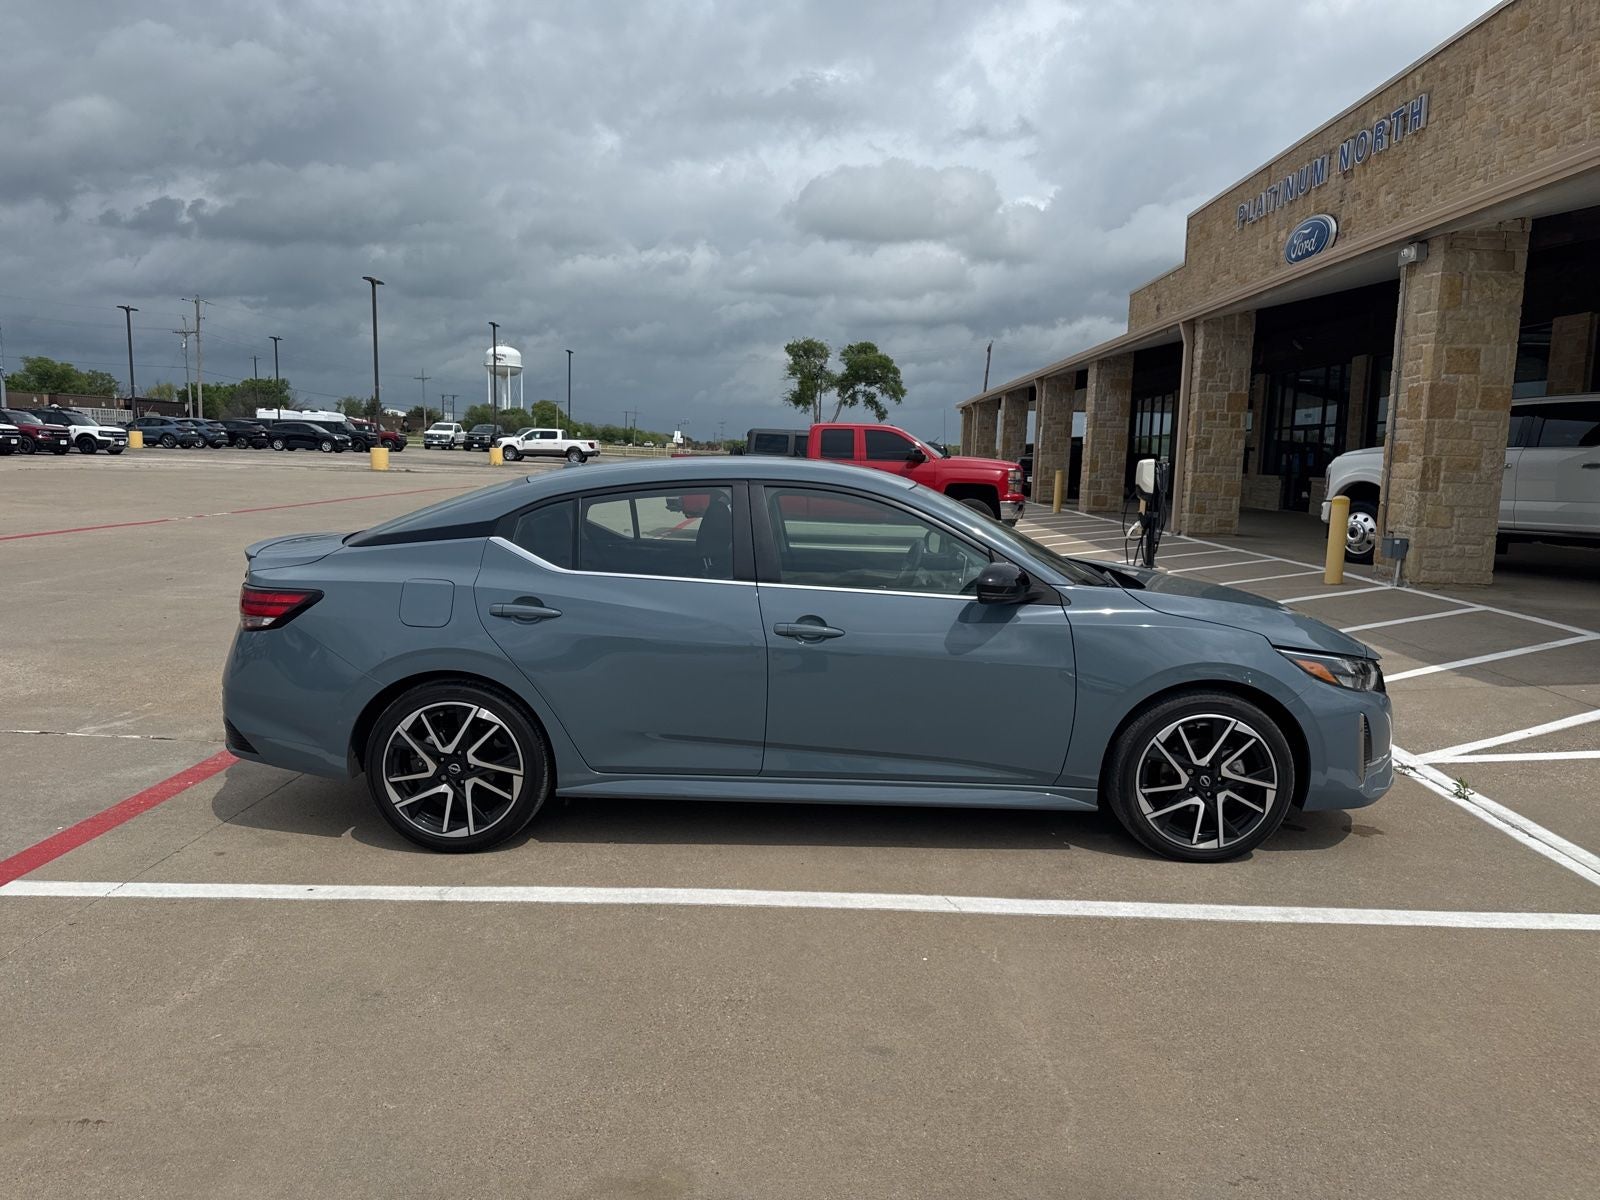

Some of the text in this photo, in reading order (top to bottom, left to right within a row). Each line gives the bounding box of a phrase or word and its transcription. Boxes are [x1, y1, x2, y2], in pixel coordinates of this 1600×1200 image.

[1237, 93, 1429, 230] PLATINUM NORTH
[1290, 227, 1318, 259] Ford
